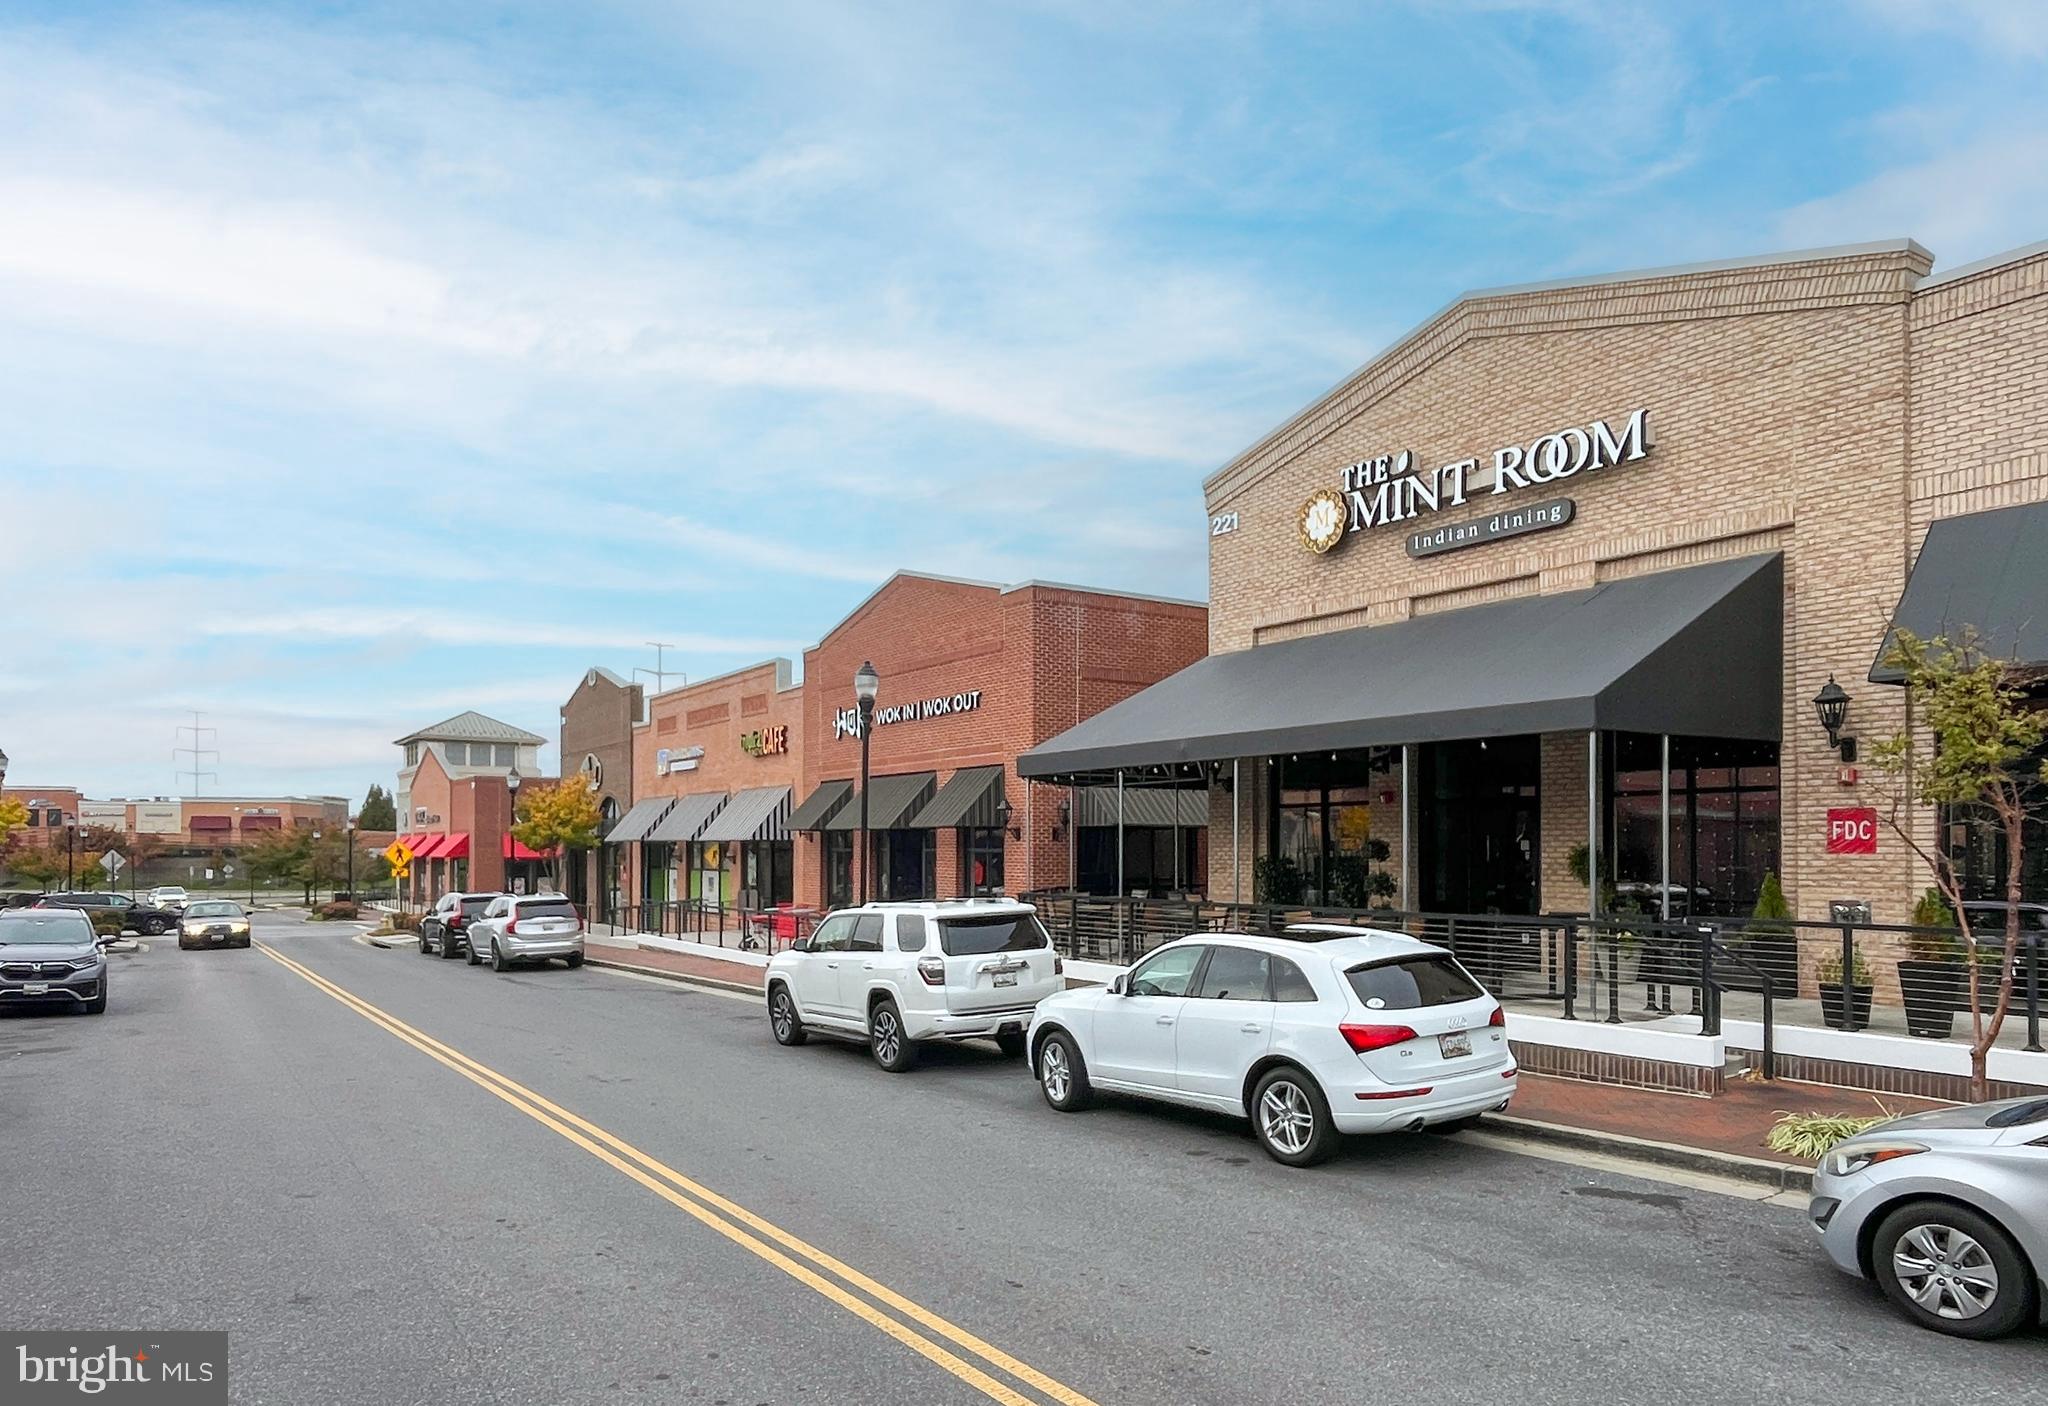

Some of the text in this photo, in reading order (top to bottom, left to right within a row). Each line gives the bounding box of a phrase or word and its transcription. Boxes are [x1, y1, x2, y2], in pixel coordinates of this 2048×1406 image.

[1340, 454, 1392, 492] THE
[1350, 408, 1649, 532] MINT ROOM
[1212, 511, 1239, 536] 221
[1414, 505, 1562, 550] Indian dining
[876, 706, 901, 725] WOK
[903, 703, 914, 720] IN
[923, 698, 951, 716] WOK
[953, 692, 980, 711] OUT
[762, 725, 787, 754] CAFE
[1832, 820, 1872, 840] FDC
